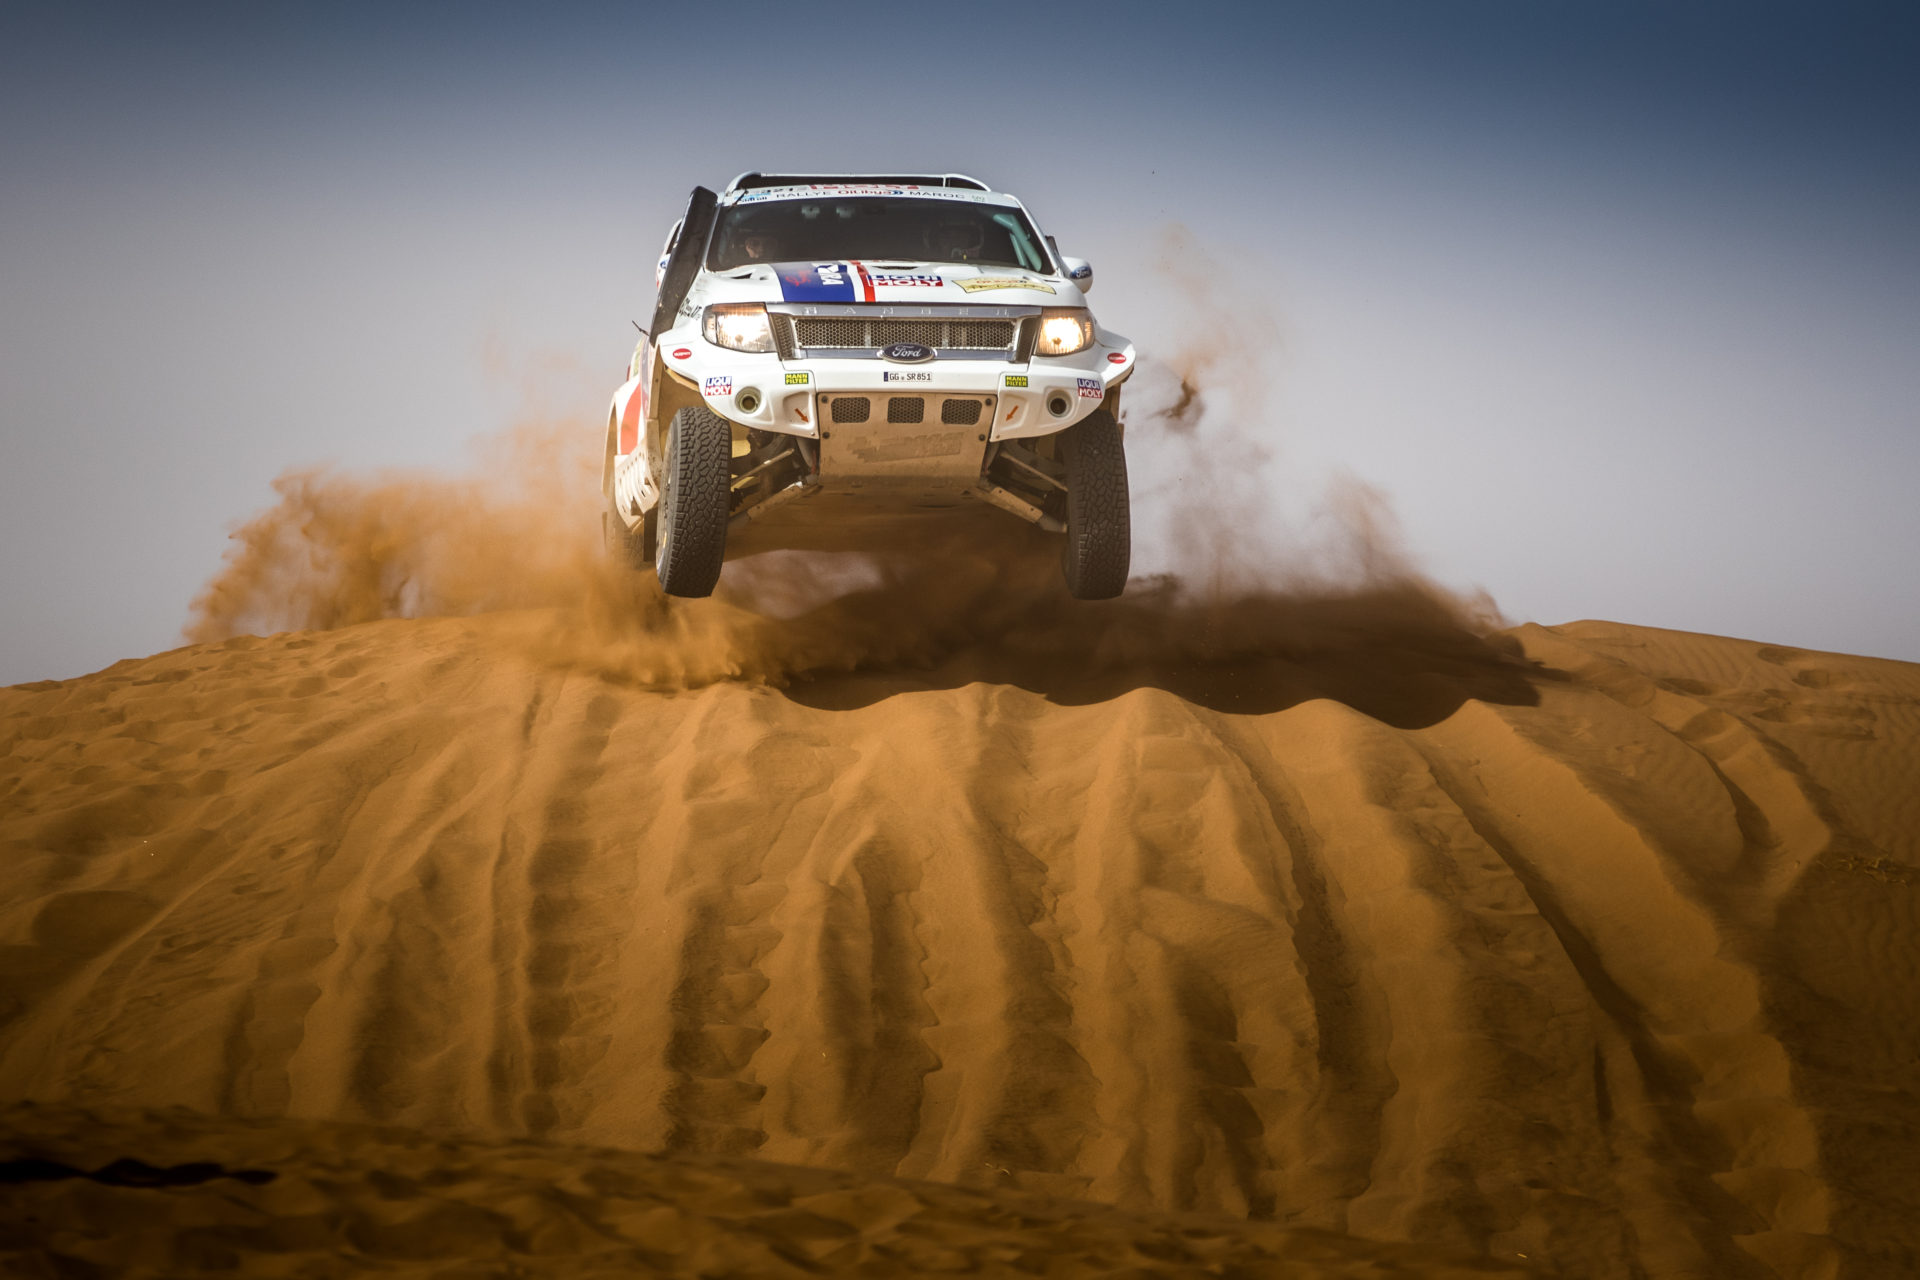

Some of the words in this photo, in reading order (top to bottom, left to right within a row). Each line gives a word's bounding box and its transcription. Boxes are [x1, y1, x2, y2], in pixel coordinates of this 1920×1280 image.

[776, 191, 831, 199] RALLYE
[909, 191, 966, 199] MAROC
[892, 346, 921, 357] Ford
[707, 376, 731, 386] LIQUI
[889, 373, 899, 381] GG
[1078, 379, 1100, 389] LIQUI
[706, 386, 730, 395] MOLY
[1079, 388, 1101, 398] MOLY
